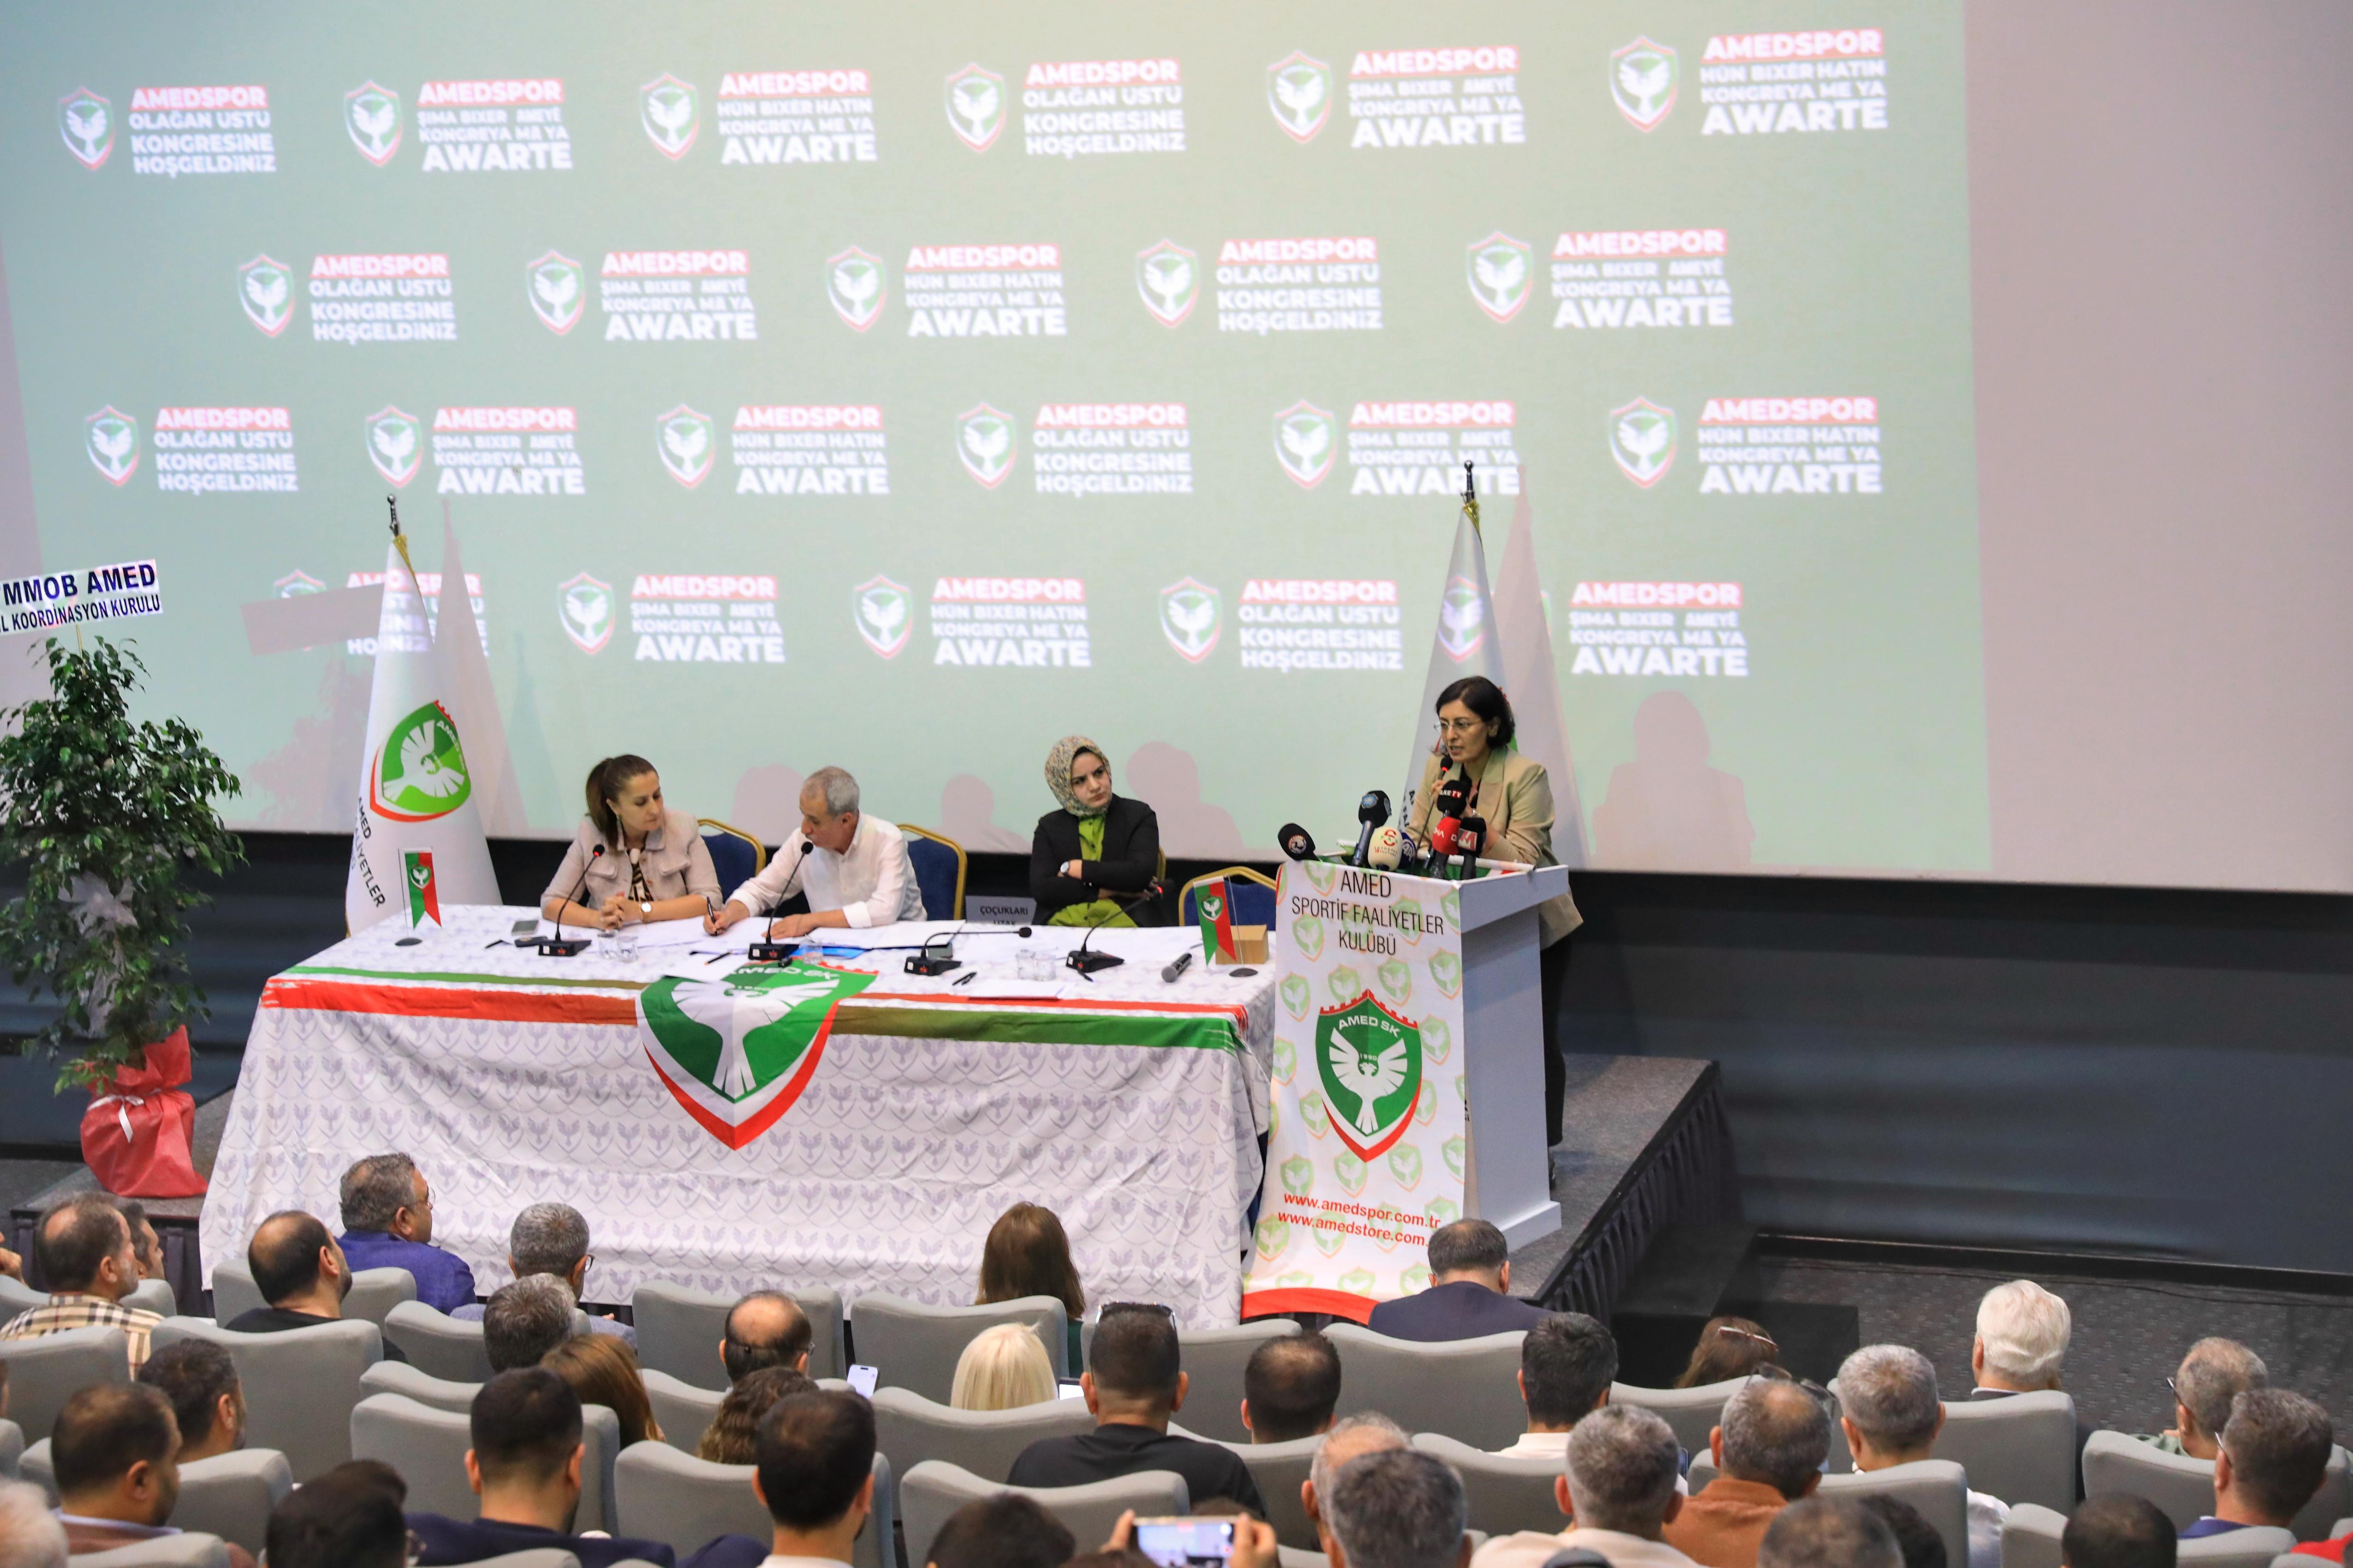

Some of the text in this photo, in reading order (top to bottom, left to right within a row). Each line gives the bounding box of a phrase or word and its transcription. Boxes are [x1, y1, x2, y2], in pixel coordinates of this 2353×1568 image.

[1703, 30, 1880, 59] AMEDSPOR
[1351, 47, 1515, 74] AMEDSPOR
[719, 71, 866, 95] AMEDSPOR
[1026, 60, 1177, 85] AMEDSPOR
[131, 86, 266, 108] AMEDSPOR
[419, 80, 560, 103] AMEDSPOR
[1701, 84, 1815, 102] KONGREYA
[1856, 80, 1886, 96] YA
[1349, 99, 1456, 116] KONGREYA
[1495, 96, 1522, 112] YA
[1701, 98, 1887, 135] AWARTE
[419, 127, 512, 142] KONGREYA
[544, 125, 569, 140] YA
[719, 119, 815, 135] KONGREYA
[848, 117, 874, 131] YA
[1351, 113, 1525, 148] AWARTE
[423, 142, 573, 171] AWARTE
[722, 133, 877, 164] AWARTE
[1220, 238, 1375, 261] AMEDSPOR
[1553, 230, 1723, 256] AMEDSPOR
[312, 255, 447, 275] AMEDSPOR
[602, 251, 746, 273] AMEDSPOR
[907, 245, 1057, 268] AMEDSPOR
[906, 292, 1004, 307] KONGREYA
[1038, 291, 1064, 305] YA
[1552, 281, 1662, 297] KONGREYA
[1701, 279, 1730, 294] YA
[602, 297, 696, 312] KONGREYA
[729, 296, 754, 311] YA
[1553, 296, 1732, 328] AWARTE
[605, 312, 757, 340] AWARTE
[908, 307, 1066, 336] AWARTE
[156, 408, 288, 427] AMEDSPOR
[434, 408, 573, 428] AMEDSPOR
[734, 406, 879, 427] AMEDSPOR
[1036, 404, 1185, 425] AMEDSPOR
[1350, 402, 1512, 425] AMEDSPOR
[1701, 398, 1874, 421] AMEDSPOR
[434, 452, 525, 466] KONGREYA
[557, 452, 581, 466] YA
[734, 451, 828, 465] KONGREYA
[861, 451, 887, 465] YA
[1349, 450, 1453, 465] KONGREYA
[1490, 449, 1517, 464] YA
[1699, 447, 1810, 463] KONGREYA
[1850, 447, 1880, 461] YA
[438, 467, 585, 494] AWARTE
[736, 467, 889, 494] AWARTE
[1699, 464, 1881, 493] AWARTE
[0, 564, 155, 606] MMOB AMED
[632, 576, 774, 597] AMEDSPOR
[933, 579, 1081, 599] AMEDSPOR
[1242, 581, 1395, 602] AMEDSPOR
[1571, 583, 1739, 605] AMEDSPOR
[0, 594, 160, 632] L KOORDİNASYON KURULU
[632, 619, 725, 633] KONGREYA
[757, 620, 782, 634] YA
[932, 622, 1029, 637] KONGREYA
[1063, 624, 1088, 637] YA
[1570, 630, 1678, 645] KONGREYA
[1717, 631, 1745, 646] YA
[635, 635, 784, 662] AWARTE
[934, 638, 1090, 666] AWARTE
[1571, 646, 1747, 676] AWARTE
[1341, 871, 1391, 898] AMED
[1291, 897, 1444, 936] SPORTİF FAALİYETLER
[1338, 930, 1397, 956] KULÜBÜ
[1338, 1015, 1401, 1038] AMED SK
[1284, 1193, 1441, 1229] www.amedspor.com.tr
[1278, 1211, 1428, 1247] www.amedstore.com.
